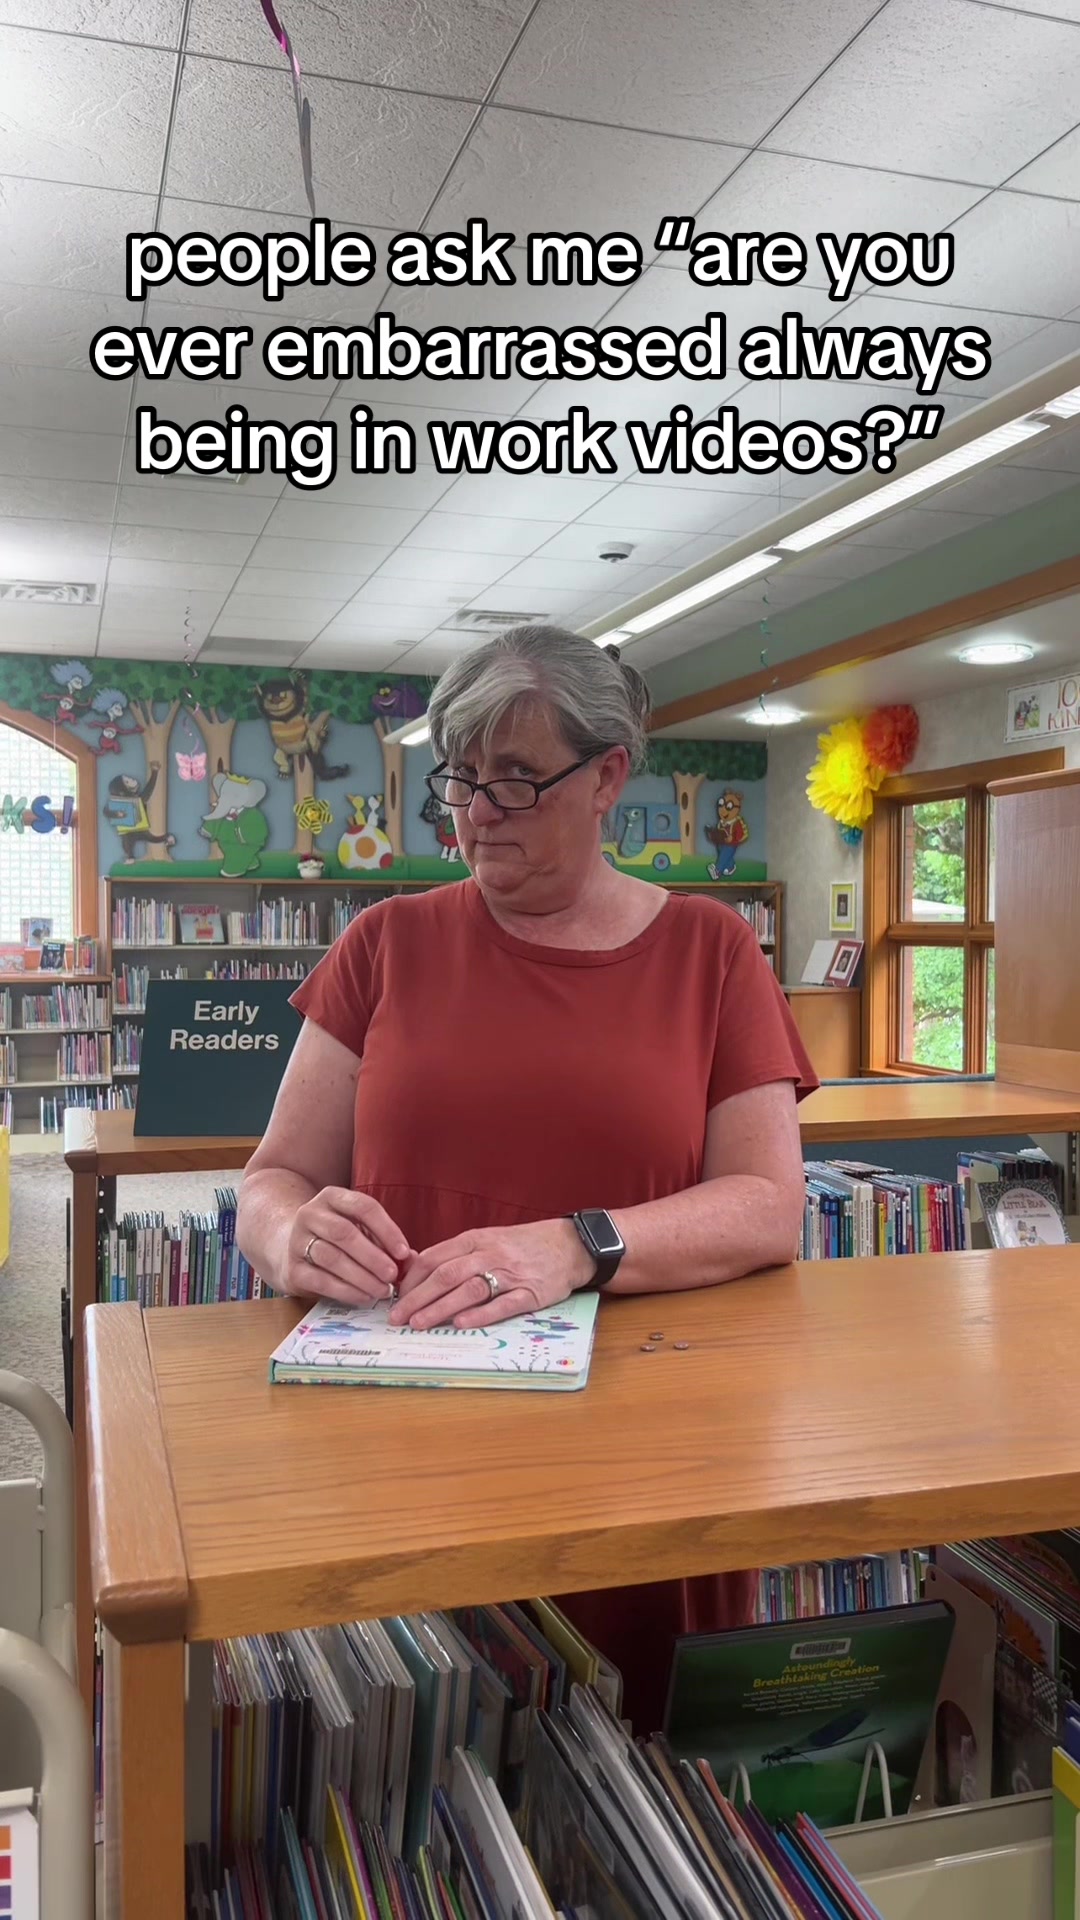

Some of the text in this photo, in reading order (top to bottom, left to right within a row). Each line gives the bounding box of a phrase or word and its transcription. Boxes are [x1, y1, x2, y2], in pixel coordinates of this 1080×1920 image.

[193, 1000, 259, 1025] Early
[169, 1028, 279, 1050] Readers
[753, 1664, 880, 1688] Breathtaking Creation
[782, 1656, 856, 1674] Astoundingly
